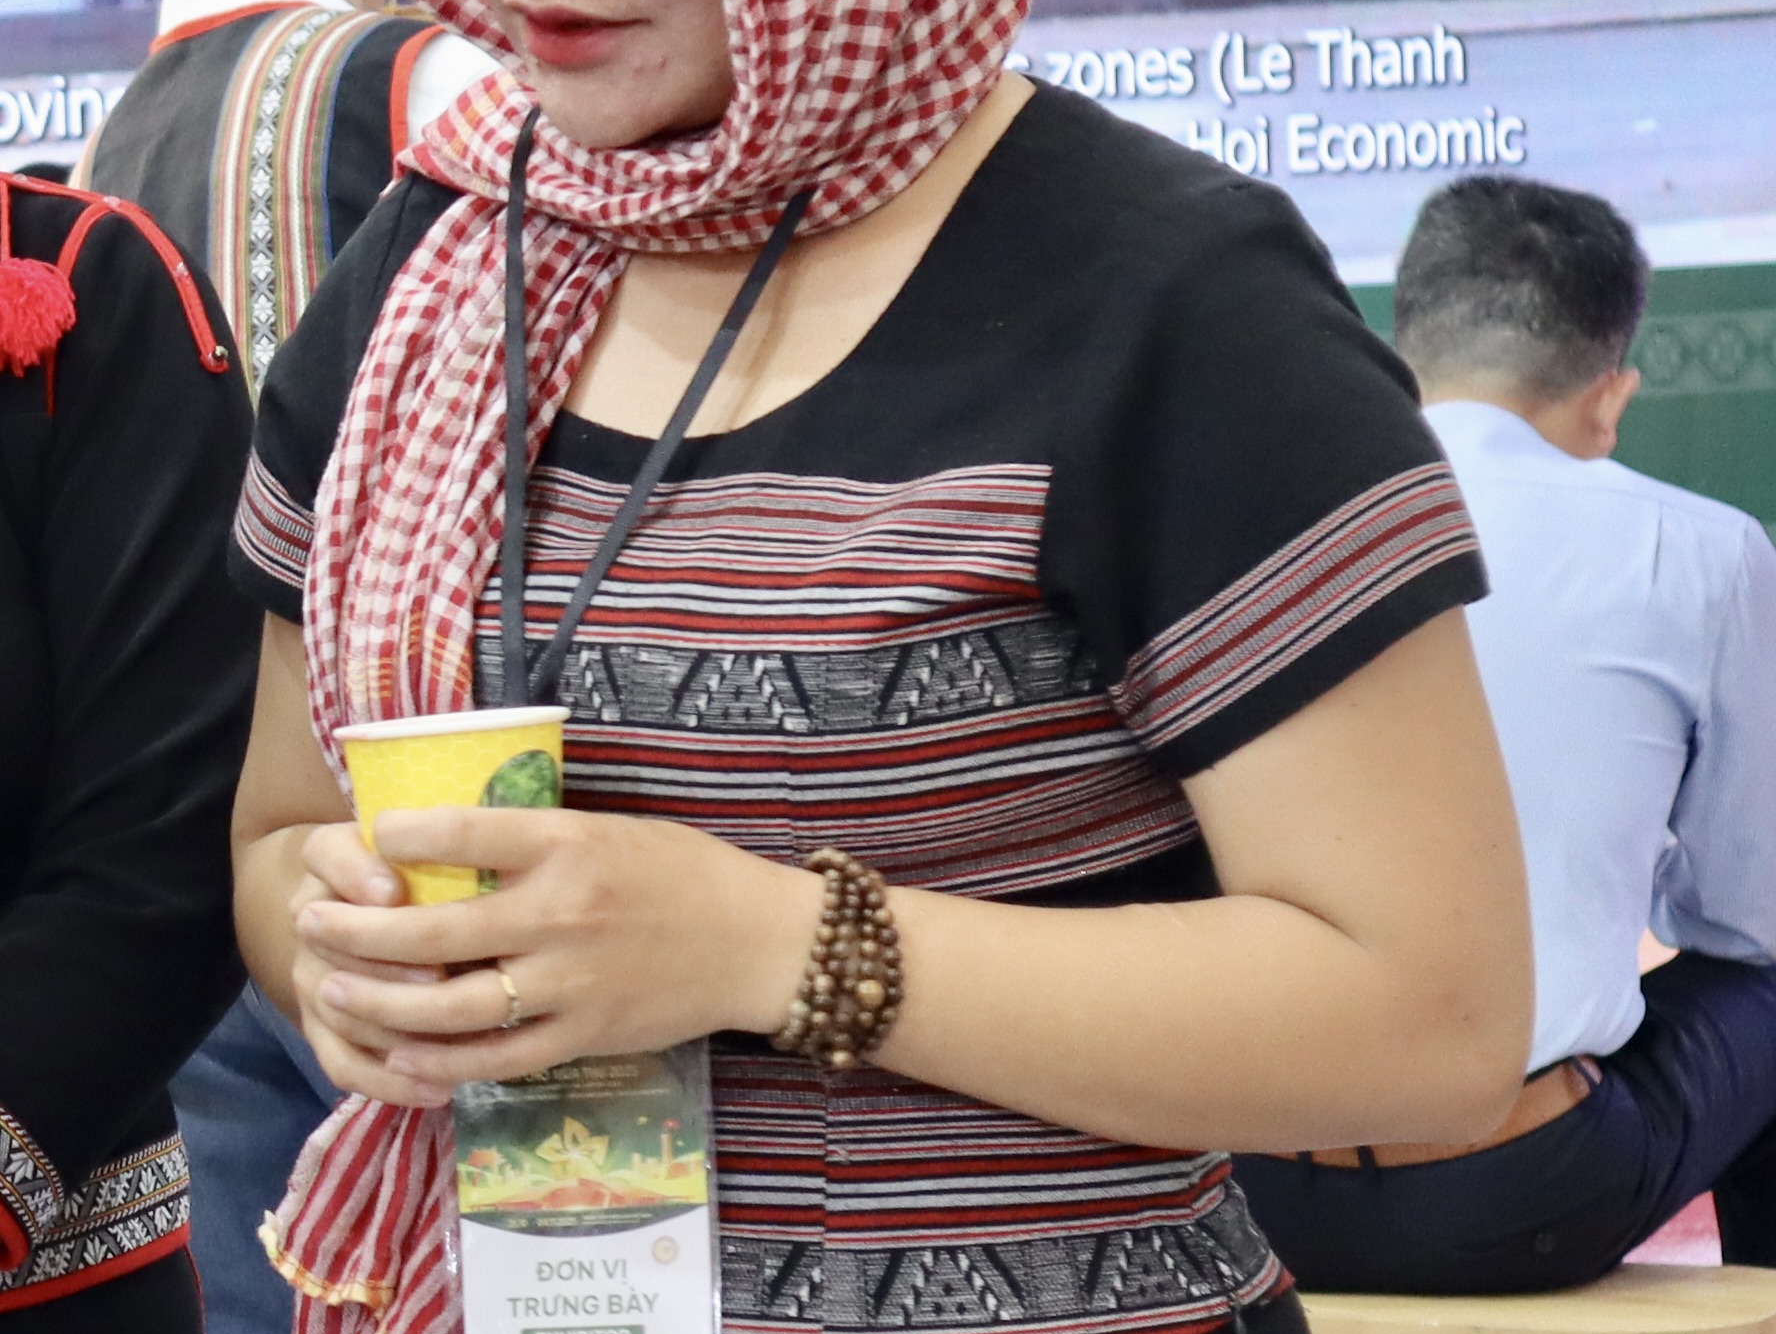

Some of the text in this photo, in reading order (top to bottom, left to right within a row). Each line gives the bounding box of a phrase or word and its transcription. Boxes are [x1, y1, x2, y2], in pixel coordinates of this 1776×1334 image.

[1046, 25, 1466, 105] zones (Le Thanh
[1188, 106, 1526, 176] Hoi Economic
[536, 1257, 628, 1285] ĐƠN VỊ
[506, 1285, 659, 1318] TRƯNG BÀY
